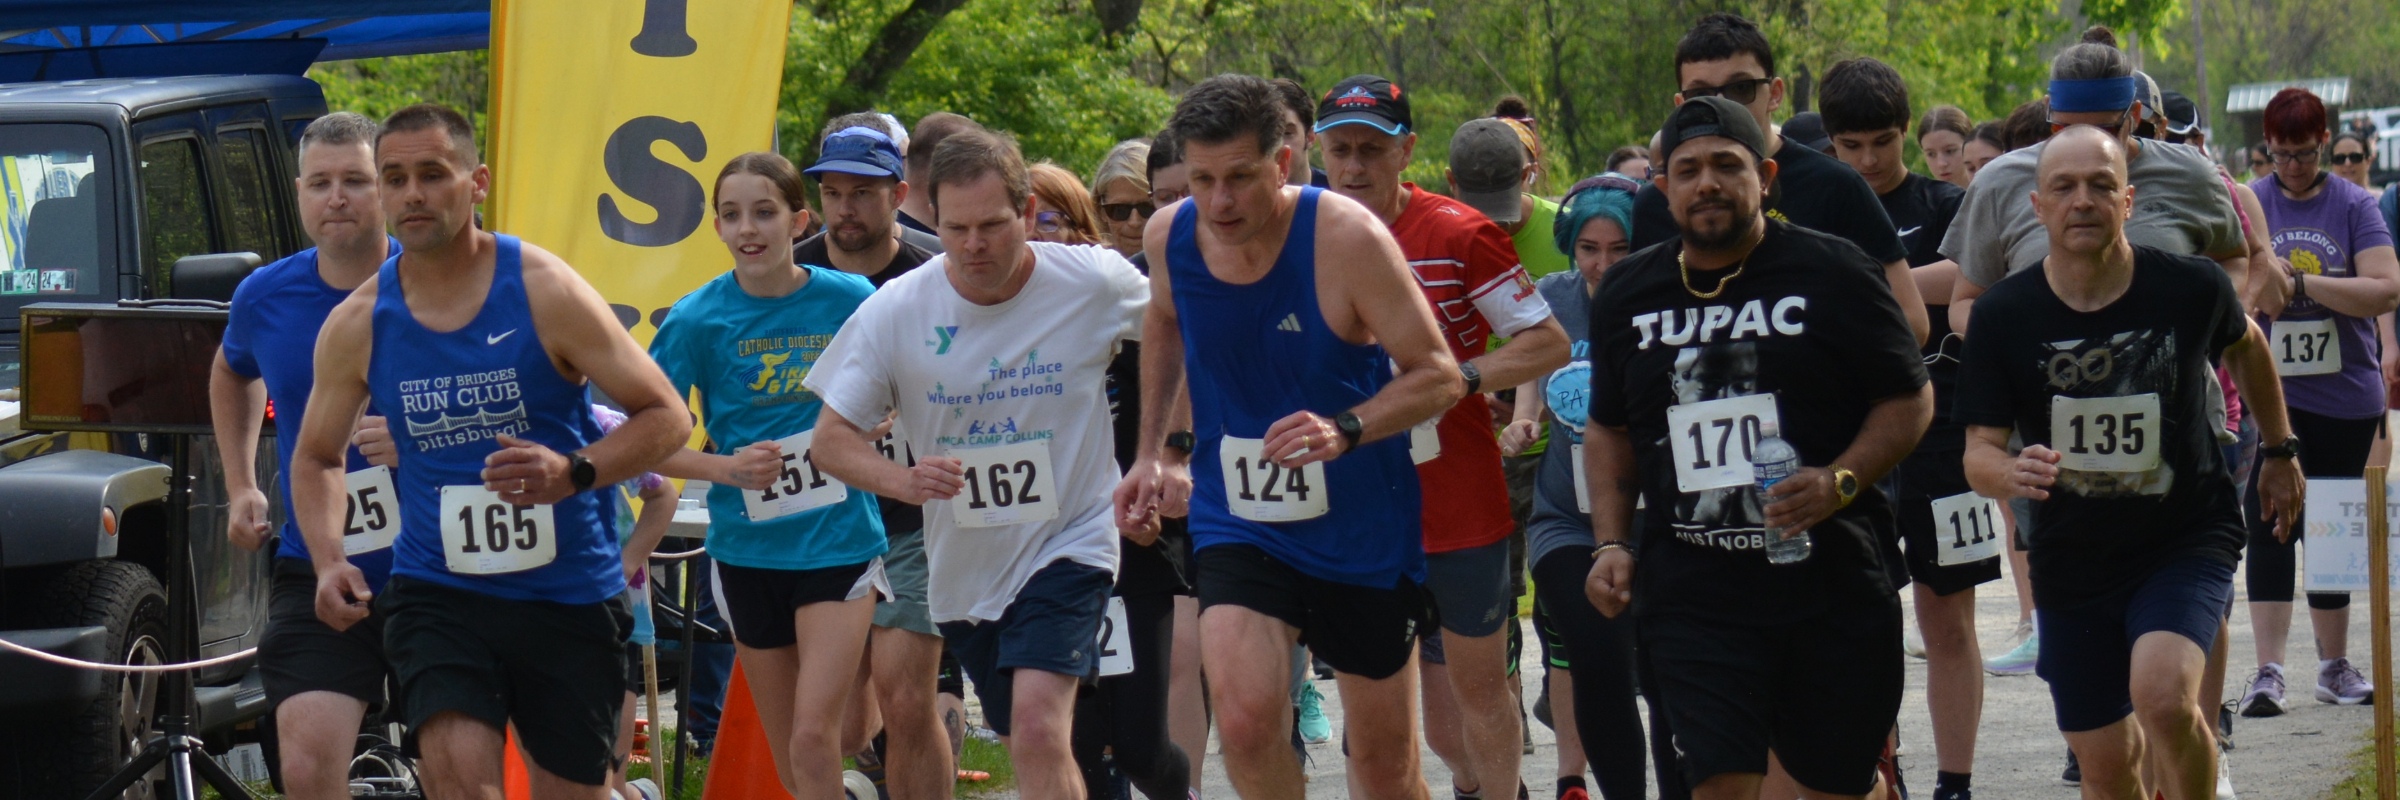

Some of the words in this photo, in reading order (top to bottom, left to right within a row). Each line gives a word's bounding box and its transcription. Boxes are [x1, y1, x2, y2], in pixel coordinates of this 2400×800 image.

[2286, 230, 2337, 256] BELONG
[27, 272, 36, 289] 24
[42, 272, 52, 289] 24
[1632, 296, 1806, 350] TUPAC
[738, 336, 784, 357] CATHOLIC
[2281, 331, 2330, 363] 137
[400, 379, 430, 393] CITY
[434, 376, 452, 389] OF
[456, 367, 517, 386] BRIDGES
[989, 367, 1017, 381] The
[1022, 361, 1062, 379] place
[2047, 348, 2113, 390] GO
[402, 390, 449, 413] RUN
[457, 381, 521, 407] CLUB
[783, 379, 812, 393] FI
[927, 390, 972, 405] Where
[977, 388, 1005, 405] you
[1010, 382, 1063, 398] belong
[935, 434, 965, 446] YMCA
[968, 433, 1002, 445] CAMP
[1005, 429, 1054, 442] COLLINS
[1687, 414, 1762, 470] 170
[2069, 411, 2144, 455] 135
[964, 459, 1041, 509] 162
[1234, 456, 1310, 502] 124
[458, 503, 538, 553] 165
[1949, 501, 1996, 549] 111
